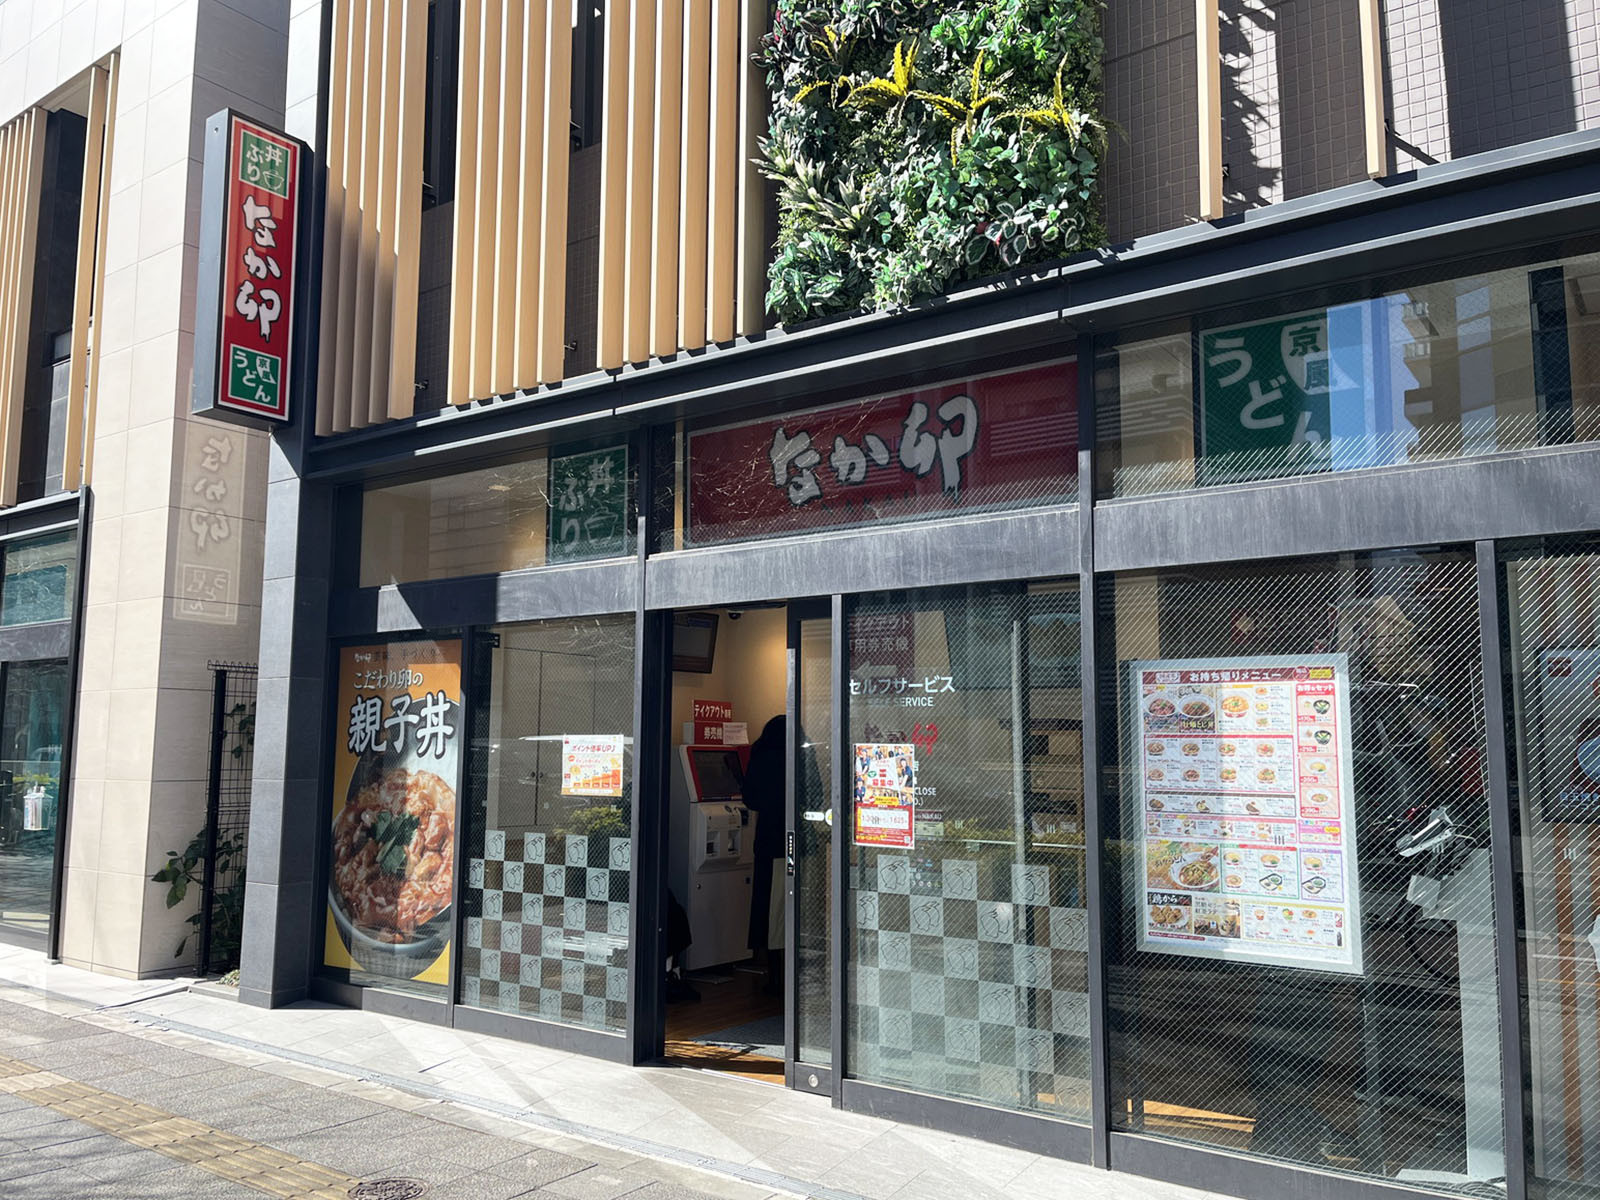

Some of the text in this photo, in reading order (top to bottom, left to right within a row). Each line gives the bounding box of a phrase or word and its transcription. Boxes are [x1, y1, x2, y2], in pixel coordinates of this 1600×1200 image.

[235, 195, 282, 342] なか卯
[234, 351, 271, 402] うどん
[1288, 326, 1338, 391] 京風
[769, 394, 980, 507] なか卯
[353, 668, 424, 689] こだわり卵の
[849, 675, 956, 695] セルフサービス
[1189, 670, 1282, 683] お持ち帰りメニュー
[894, 697, 934, 707] SERVICE
[347, 690, 456, 759] 親子丼
[914, 787, 937, 796] CLOSE
